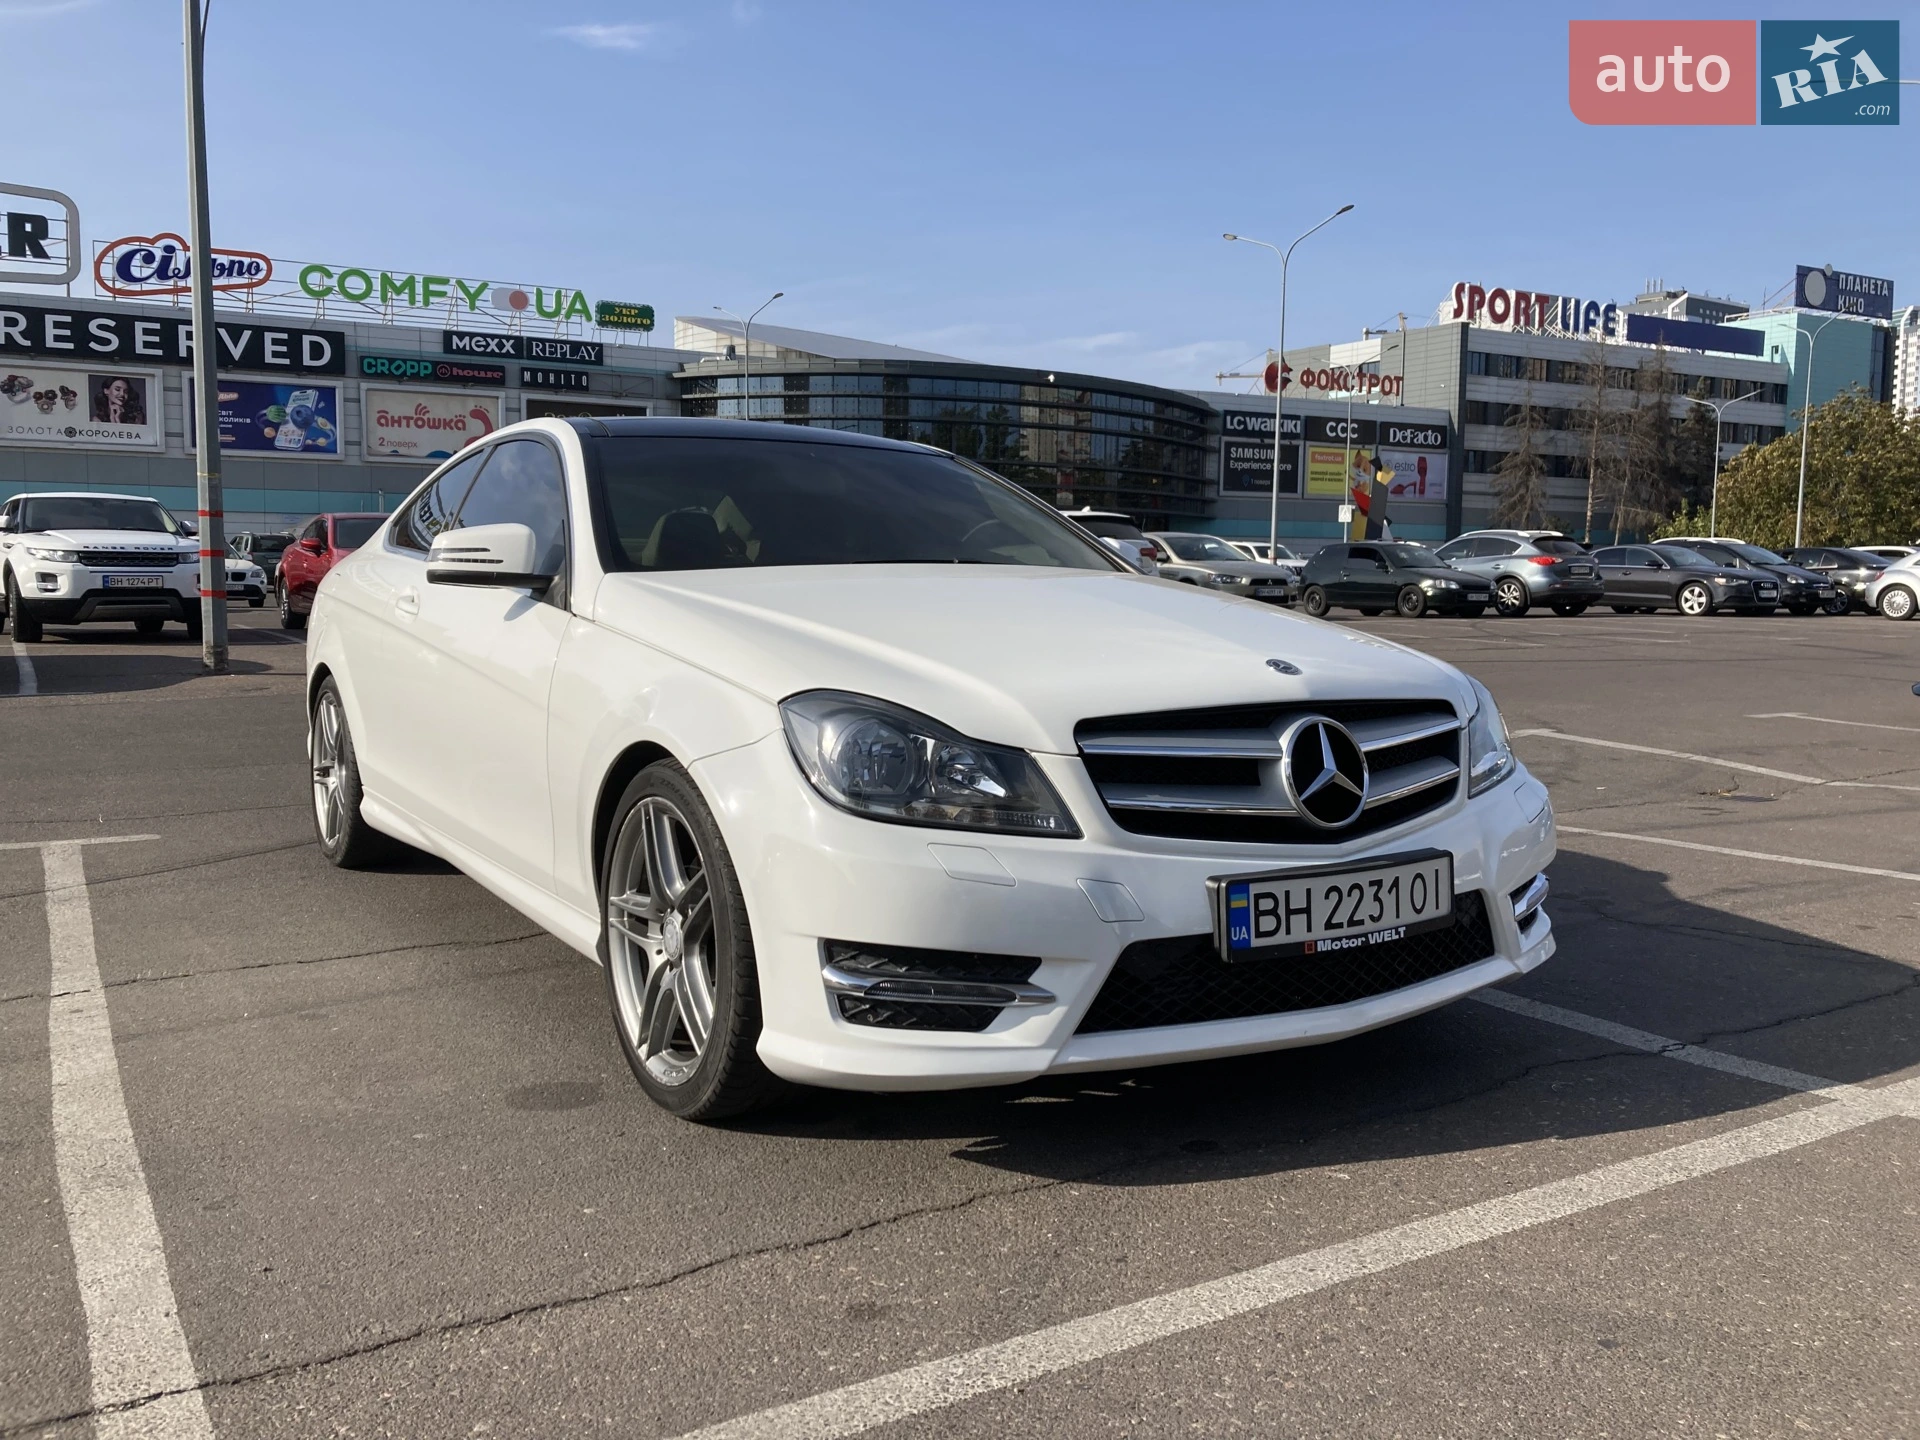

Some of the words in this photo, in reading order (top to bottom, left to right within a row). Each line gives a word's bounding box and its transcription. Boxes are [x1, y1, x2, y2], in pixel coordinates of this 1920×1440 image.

[0, 211, 51, 260] R
[298, 264, 489, 312] COMFY
[1839, 274, 1889, 296] ПЛАНЕТА
[614, 307, 639, 316] УКР
[1453, 282, 1549, 329] SPORT
[1558, 296, 1617, 336] LIFE
[1838, 295, 1864, 313] КІНО
[601, 314, 651, 325] ЗОЛОТО
[531, 341, 600, 361] REPLAY
[363, 358, 432, 377] CROPP
[452, 367, 504, 379] house
[523, 370, 588, 387] MOHITO
[1300, 367, 1404, 396] ФОКСТРОТ
[219, 416, 251, 424] КОЛИКІВ
[1226, 415, 1244, 430] LC
[8, 425, 63, 436] ЗОЛОТА
[78, 429, 141, 439] КОРОЛЕВА
[1326, 421, 1359, 439] CCC
[1389, 427, 1441, 445] DeFacto
[378, 436, 386, 446] 2
[386, 438, 418, 449] поверх
[1230, 447, 1279, 460] SAMSUN
[1229, 460, 1272, 471] Experience
[1272, 463, 1292, 471] ore
[1394, 461, 1416, 472] estro
[110, 578, 122, 586] BH
[127, 577, 146, 586] 1274
[147, 577, 160, 586] PT
[1253, 887, 1312, 939] BH
[1323, 875, 1401, 931] 2231
[1231, 925, 1249, 941] UA
[1316, 935, 1366, 952] Motor
[1367, 926, 1406, 946] WELT
